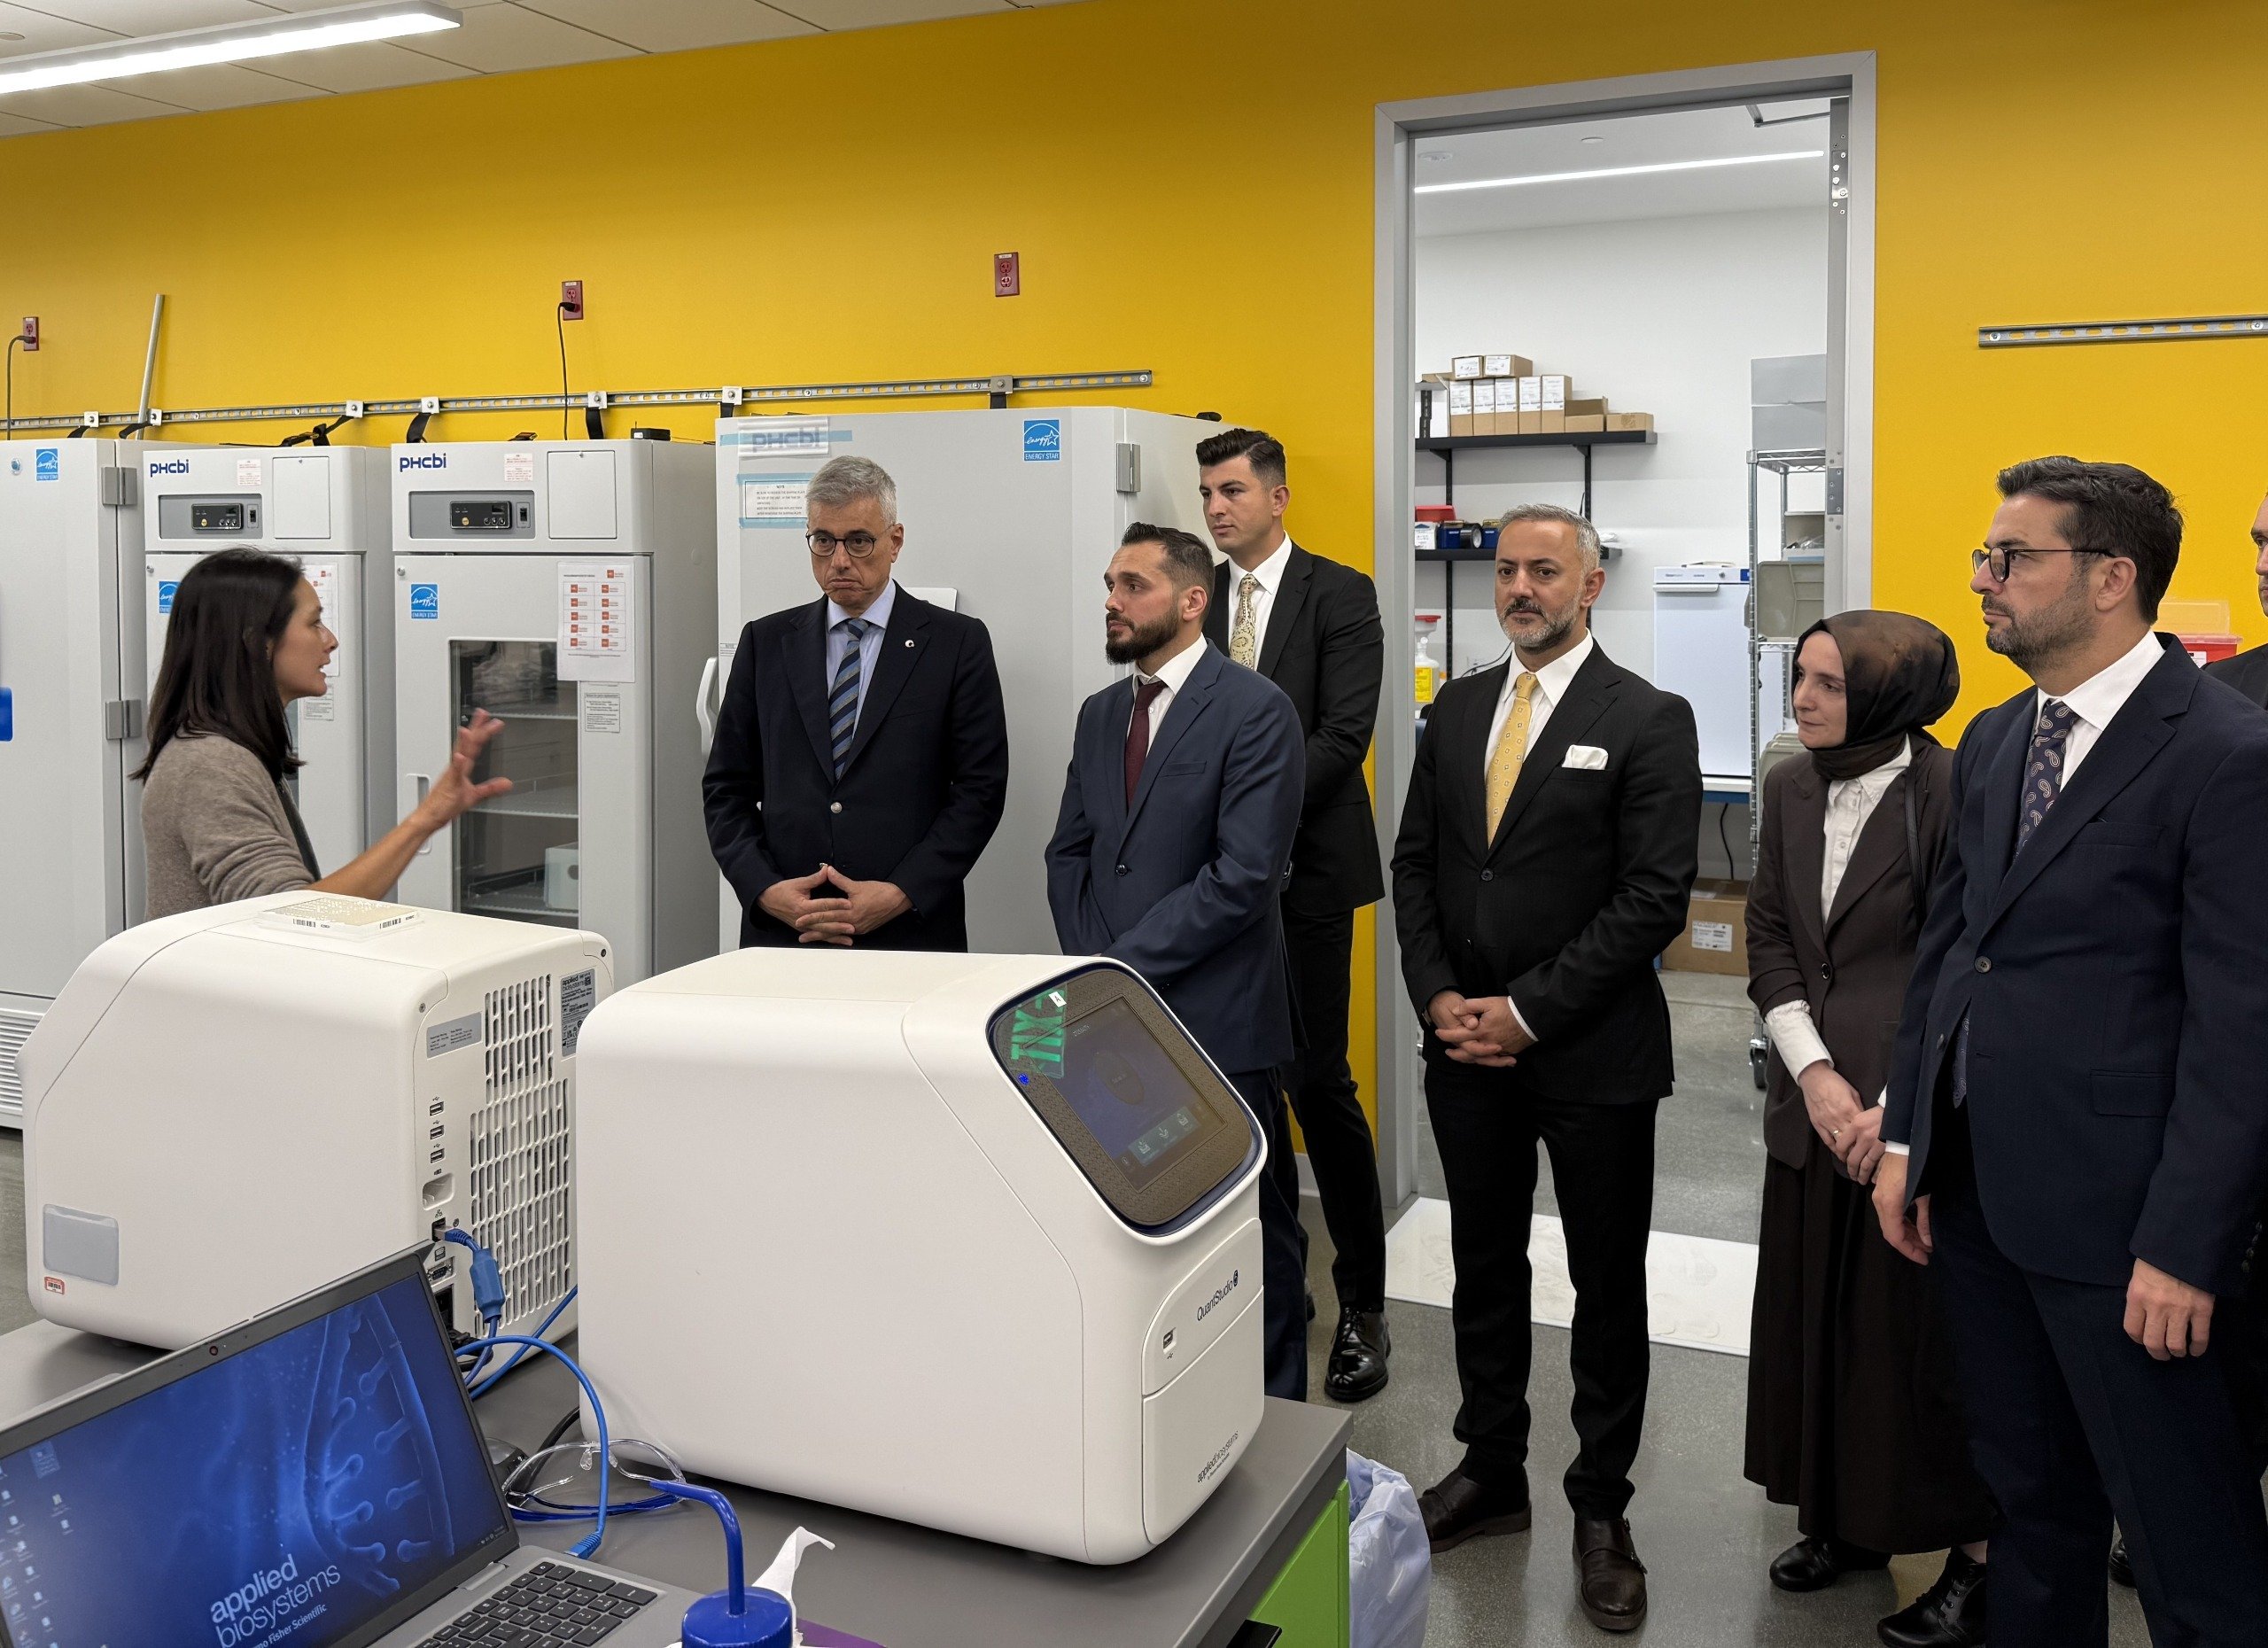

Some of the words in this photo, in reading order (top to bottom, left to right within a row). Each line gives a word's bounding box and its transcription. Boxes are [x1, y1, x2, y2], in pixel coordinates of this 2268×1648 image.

[1197, 1279, 1233, 1321] QuantStudio
[211, 1553, 298, 1623] applied
[215, 1565, 341, 1648] biosystems
[268, 1625, 291, 1644] Fisher
[292, 1604, 328, 1629] Scientific
